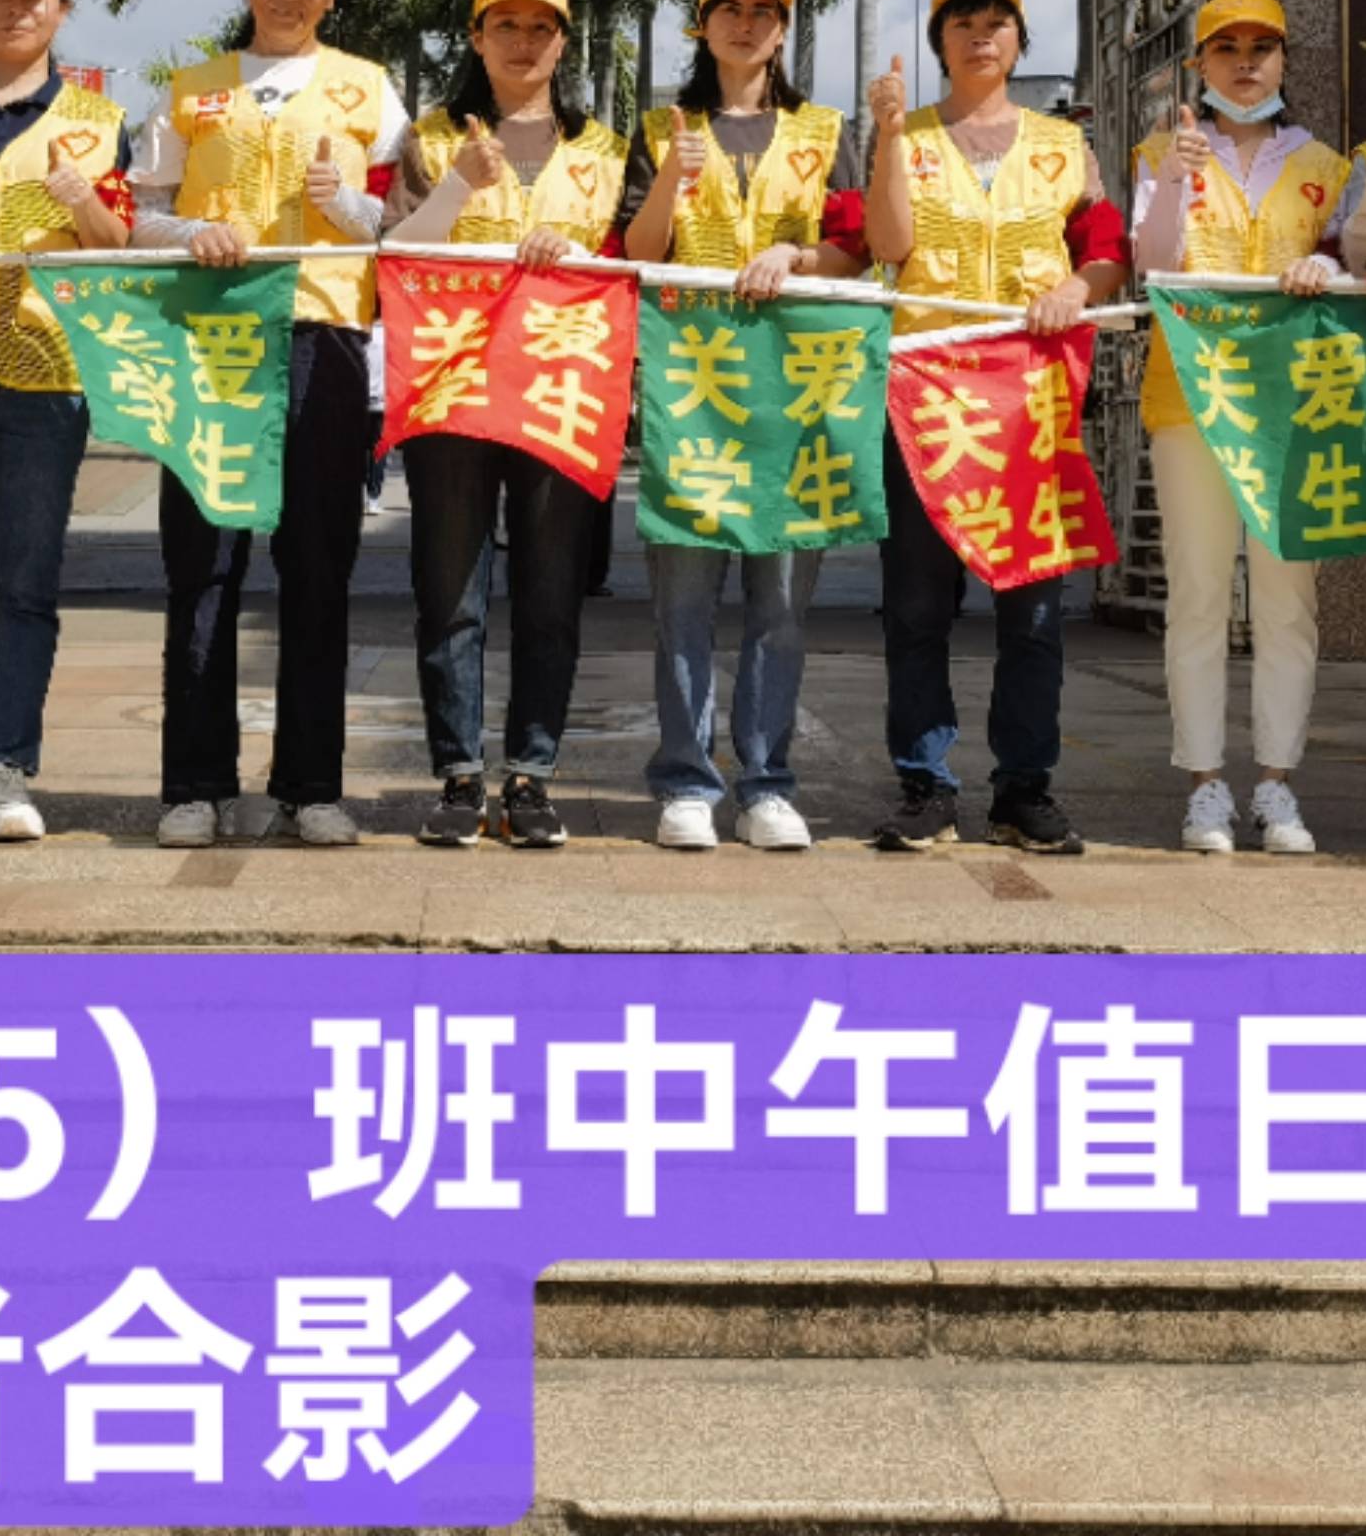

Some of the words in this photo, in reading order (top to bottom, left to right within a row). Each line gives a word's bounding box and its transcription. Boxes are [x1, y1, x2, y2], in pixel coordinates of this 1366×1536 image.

[665, 323, 867, 427] 关爱
[665, 435, 862, 536] 学生
[943, 474, 1099, 572] 学生
